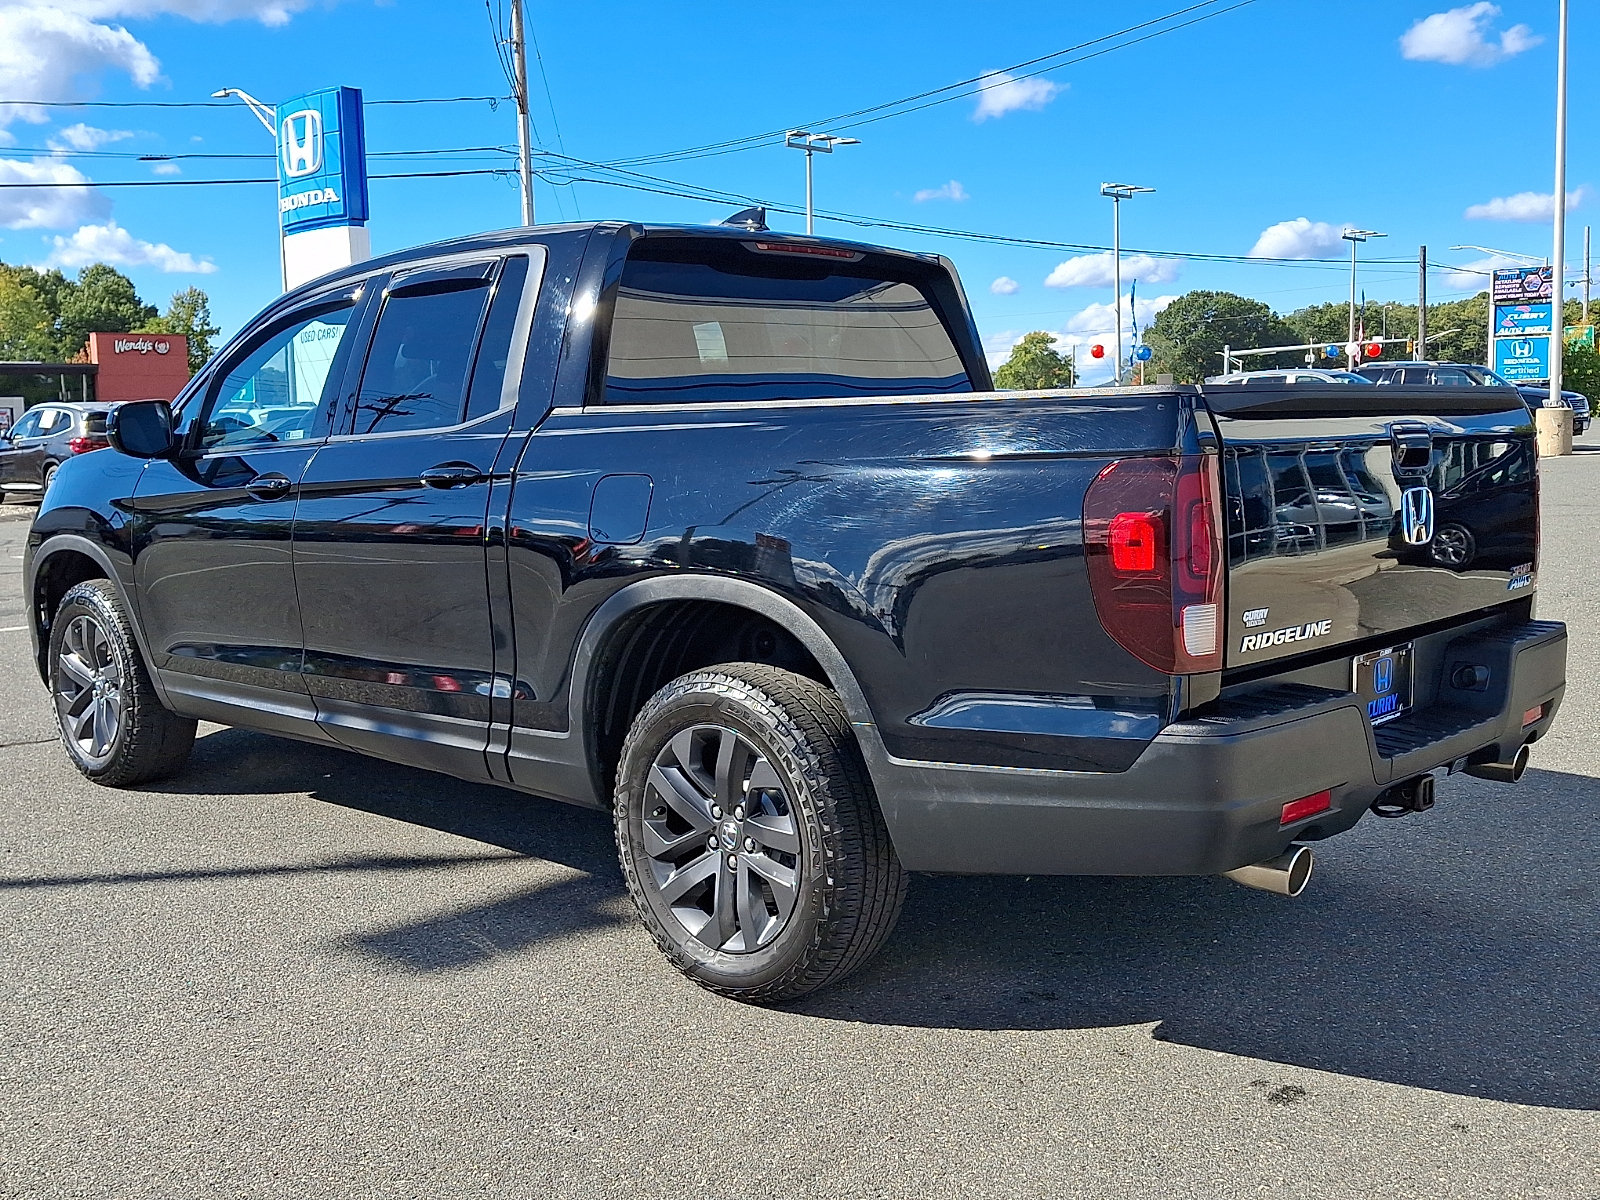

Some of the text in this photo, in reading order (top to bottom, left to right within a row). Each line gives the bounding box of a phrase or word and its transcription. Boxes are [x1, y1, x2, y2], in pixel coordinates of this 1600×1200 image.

[280, 188, 340, 213] HONDA
[114, 337, 153, 354] Wendy's
[300, 326, 339, 344] USED CARS!
[1503, 366, 1540, 375] Certified
[1243, 608, 1269, 622] CURRY
[1240, 619, 1333, 654] RIDGELINE
[1367, 693, 1399, 718] CURRY
[726, 701, 823, 871] DESTINATION
